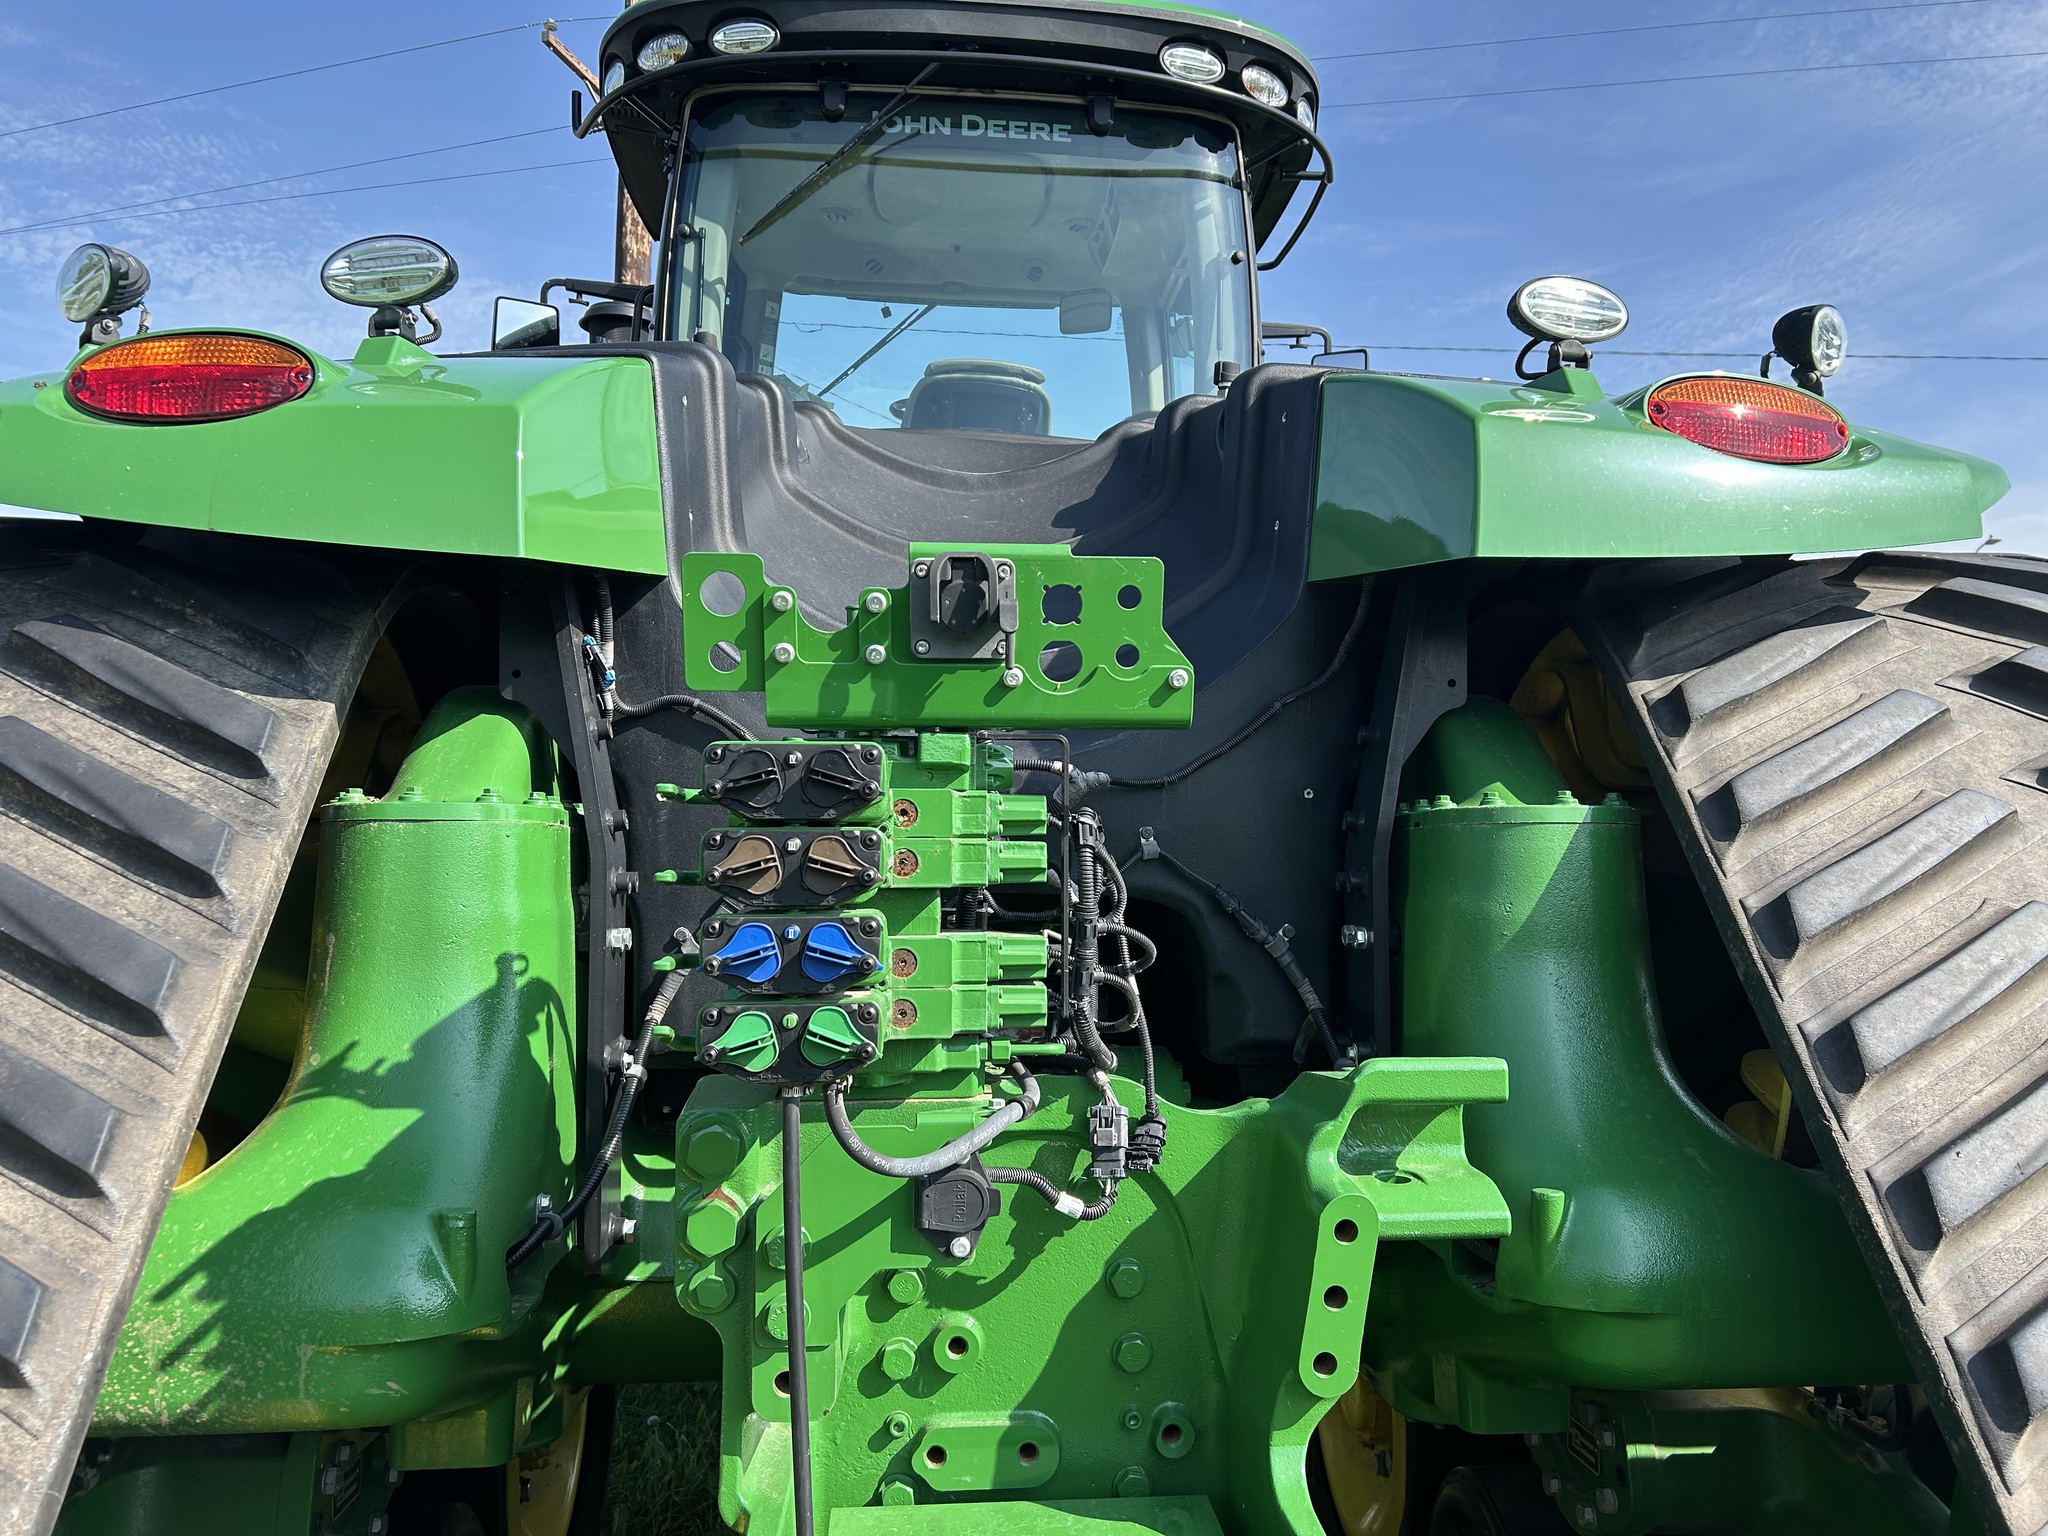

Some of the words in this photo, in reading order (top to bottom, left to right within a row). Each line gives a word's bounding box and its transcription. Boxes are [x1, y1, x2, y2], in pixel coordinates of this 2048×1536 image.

[961, 114, 1072, 143] DEERE
[848, 1135, 862, 1151] USA
[862, 1148, 870, 1159] in
[873, 1155, 891, 1170] Made
[952, 1183, 967, 1223] Pollak
